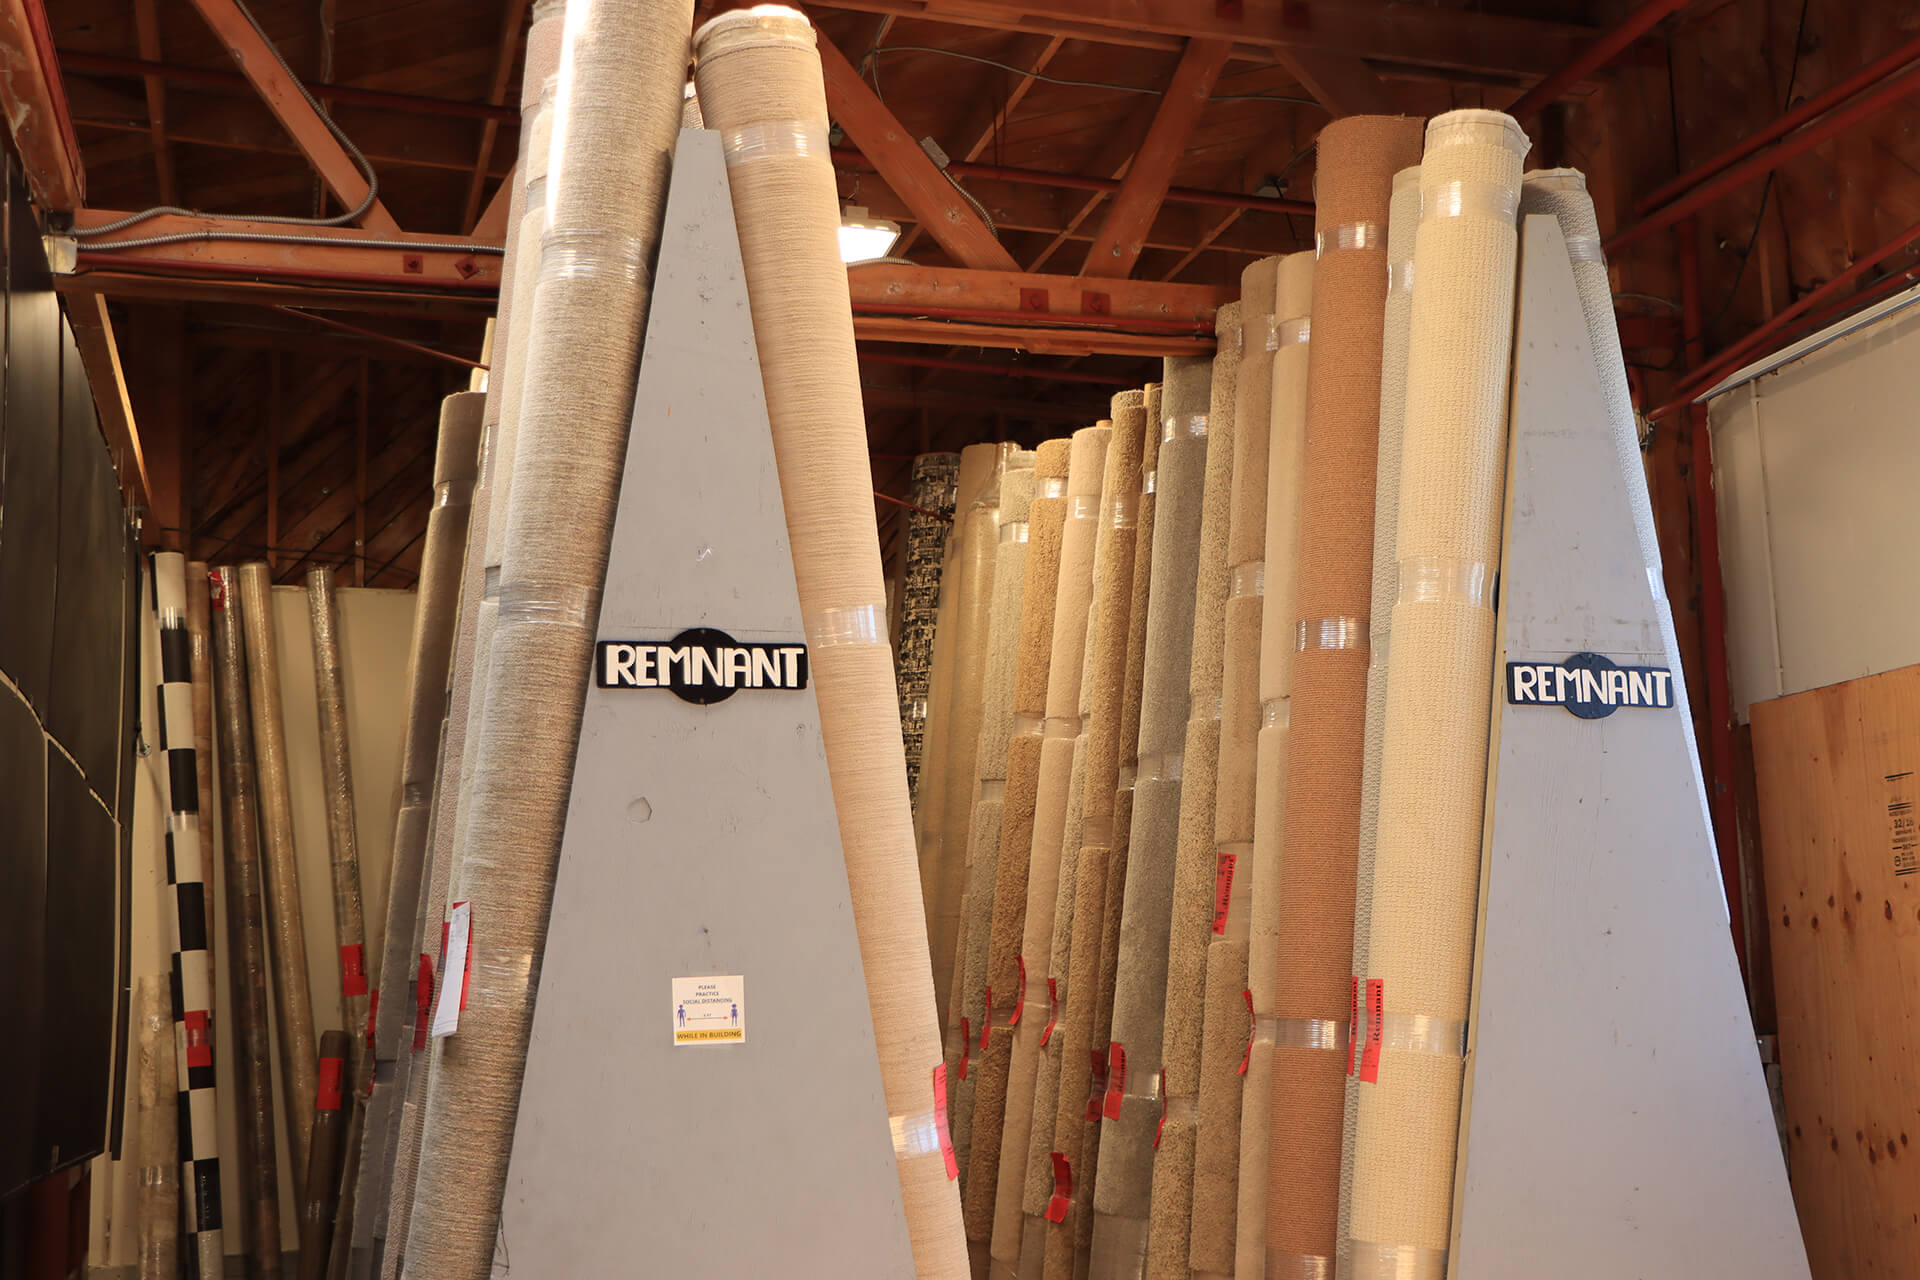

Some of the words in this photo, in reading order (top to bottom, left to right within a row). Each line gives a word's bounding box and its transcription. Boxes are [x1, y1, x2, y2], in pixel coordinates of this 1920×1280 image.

[606, 645, 804, 688] REMNANT
[1513, 666, 1671, 706] REMNANT
[677, 1032, 698, 1040] WHILE
[709, 1030, 742, 1038] BUILDING
